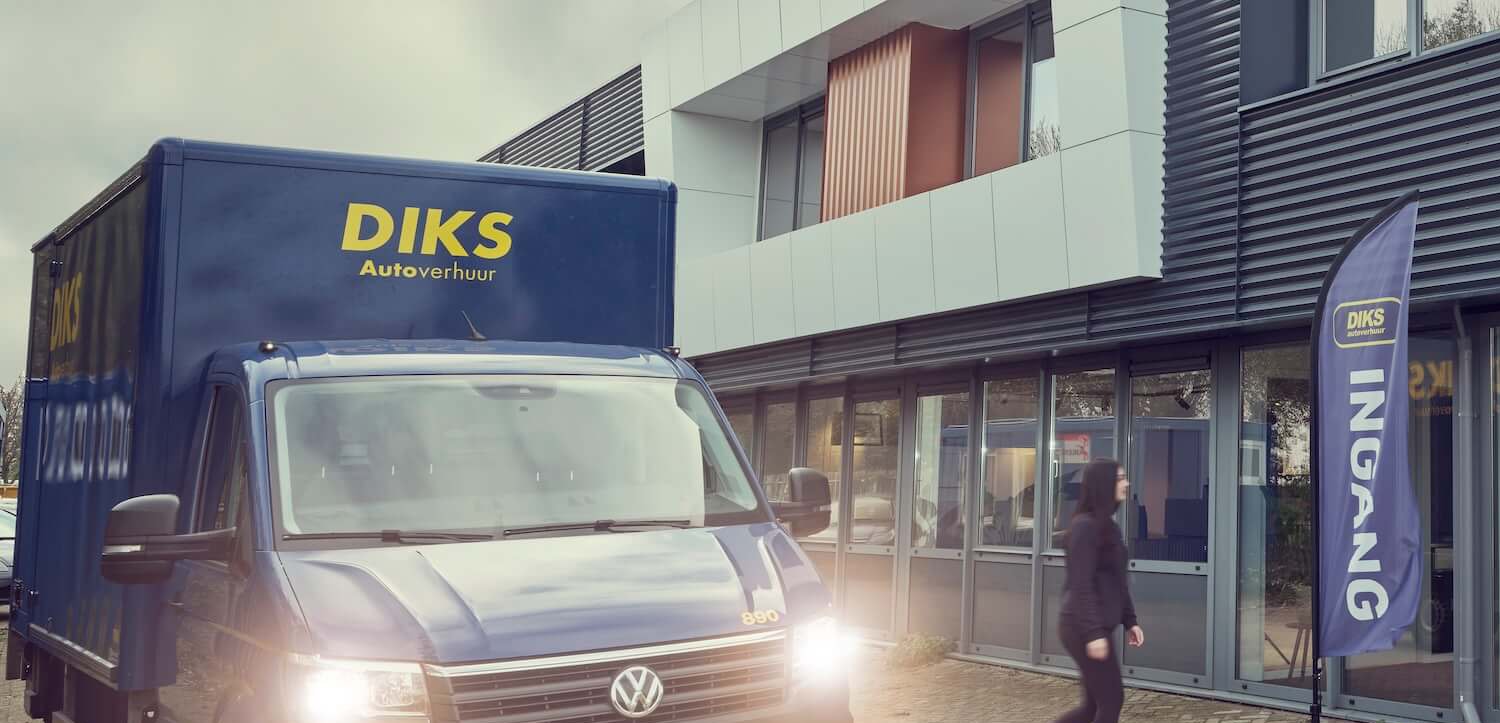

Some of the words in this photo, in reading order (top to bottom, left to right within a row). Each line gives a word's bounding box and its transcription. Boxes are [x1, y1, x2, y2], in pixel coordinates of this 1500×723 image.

[341, 202, 514, 259] DIKS
[359, 259, 497, 281] Autoverhuur
[50, 271, 82, 352] DIKS
[1347, 307, 1385, 329] DIKS
[1346, 368, 1389, 621] INGANG
[741, 609, 779, 626] 890
